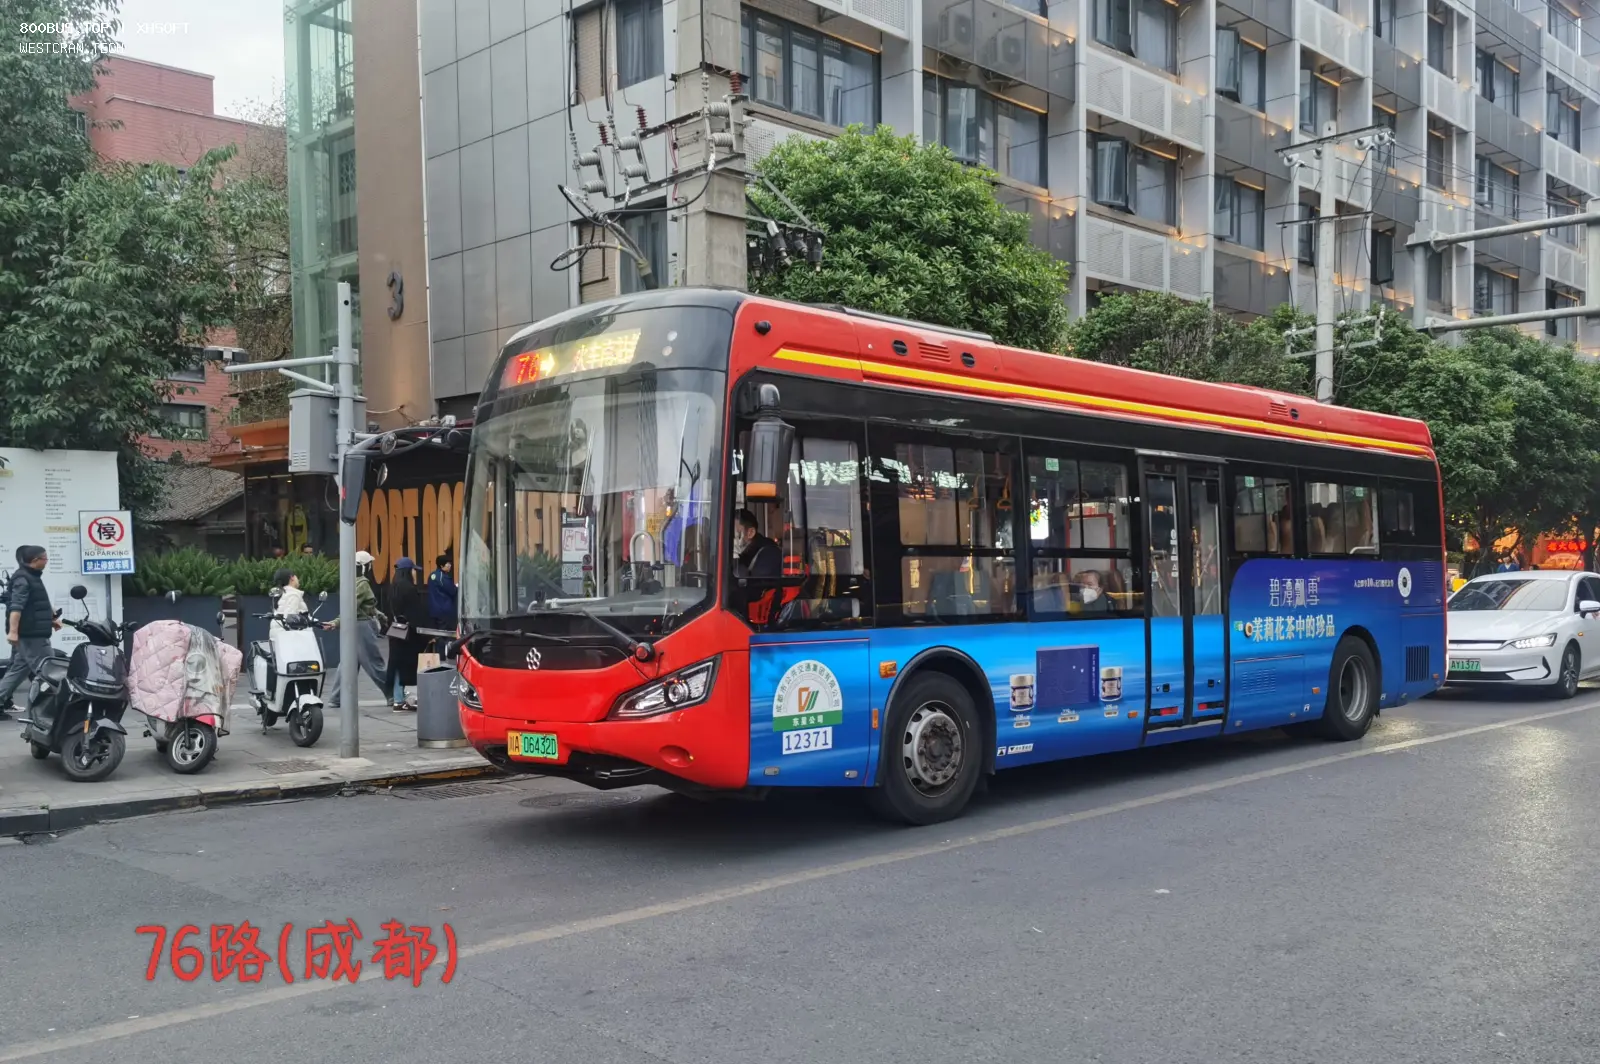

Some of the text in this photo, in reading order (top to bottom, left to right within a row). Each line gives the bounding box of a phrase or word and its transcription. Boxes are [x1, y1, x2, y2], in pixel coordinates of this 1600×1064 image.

[97, 522, 117, 541] 停
[1252, 614, 1336, 642] 茉莉花茶中的珍品
[784, 730, 829, 752] 12371
